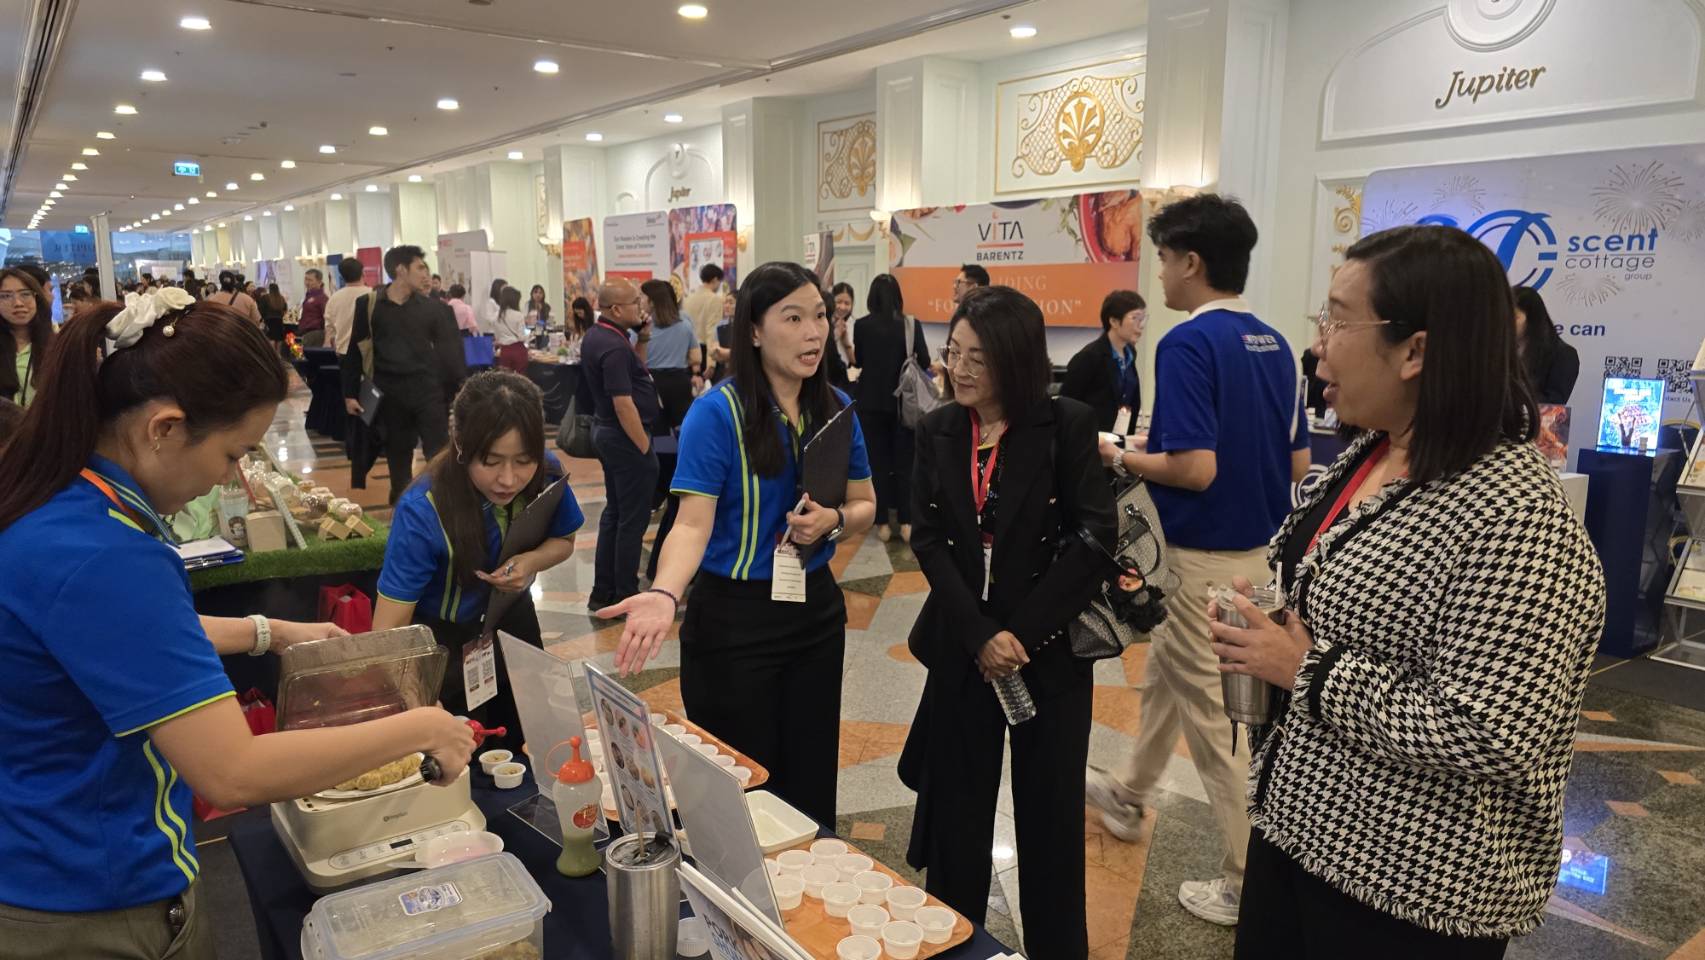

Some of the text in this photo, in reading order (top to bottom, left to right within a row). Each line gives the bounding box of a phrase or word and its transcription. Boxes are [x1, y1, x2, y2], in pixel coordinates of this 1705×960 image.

[1435, 66, 1546, 109] Jupiter
[1568, 228, 1658, 251] scent
[976, 251, 1024, 261] BARENTZ
[1565, 254, 1655, 272] cottage
[1624, 273, 1652, 281] group
[1570, 324, 1606, 336] can
